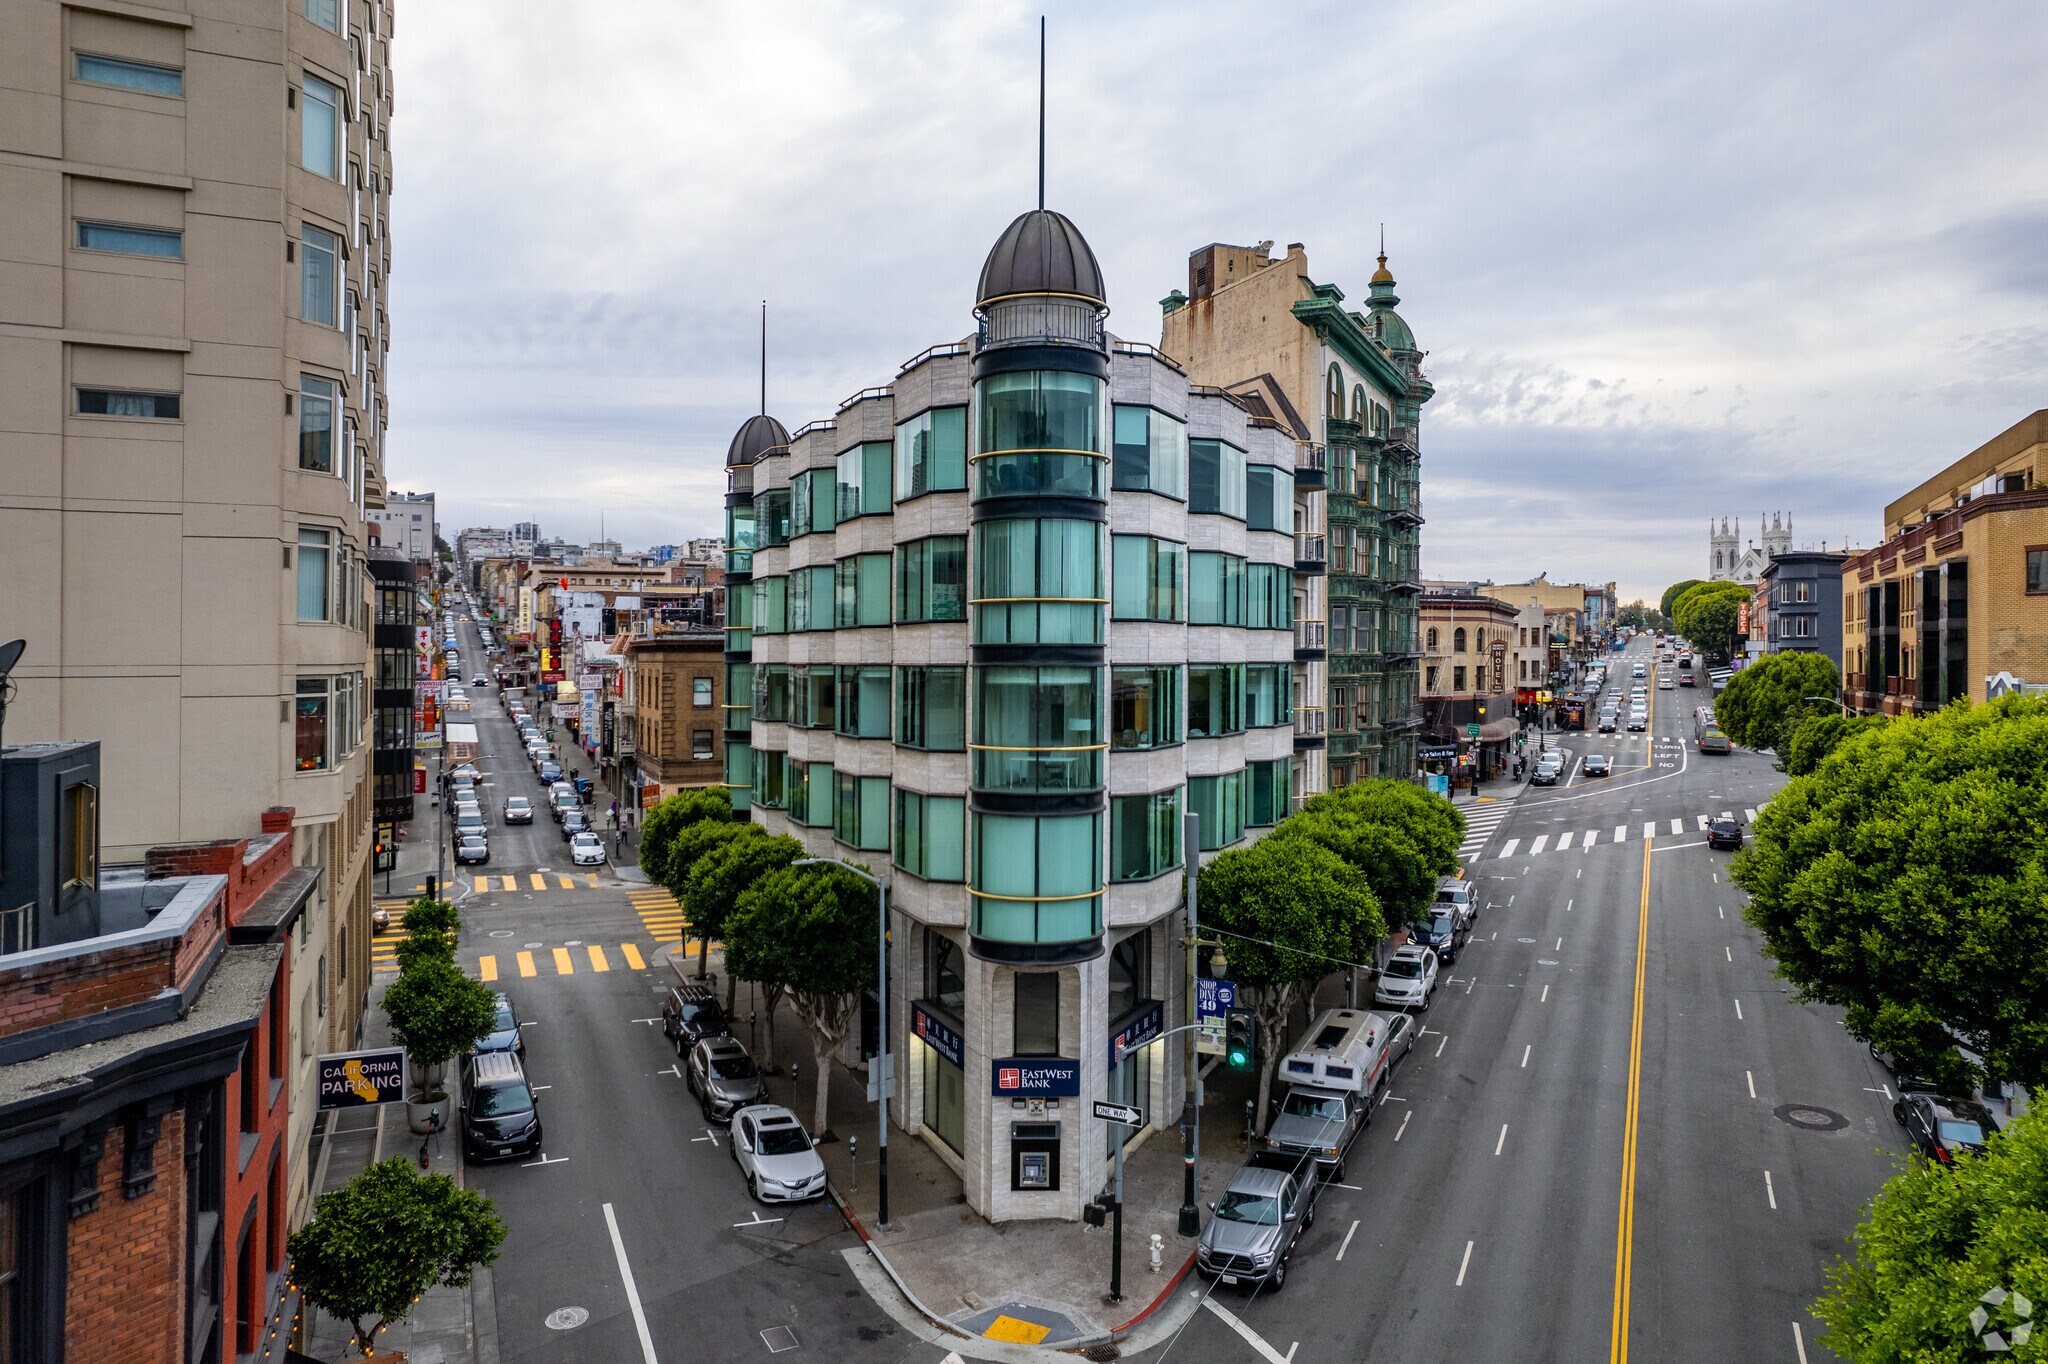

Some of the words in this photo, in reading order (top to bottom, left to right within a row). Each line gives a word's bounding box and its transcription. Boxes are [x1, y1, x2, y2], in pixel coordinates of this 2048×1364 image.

[1739, 603, 1747, 633] TOSCA
[1199, 979, 1217, 990] SHOP
[1199, 989, 1217, 1001] DINE
[1199, 1000, 1217, 1011] 49
[323, 1061, 398, 1078] CALIFORNIA
[1021, 1068, 1073, 1079] EASTWEST
[322, 1075, 401, 1095] PARKING
[1021, 1079, 1051, 1088] BANK
[1097, 1106, 1111, 1116] ONE
[1113, 1109, 1128, 1118] WAY
